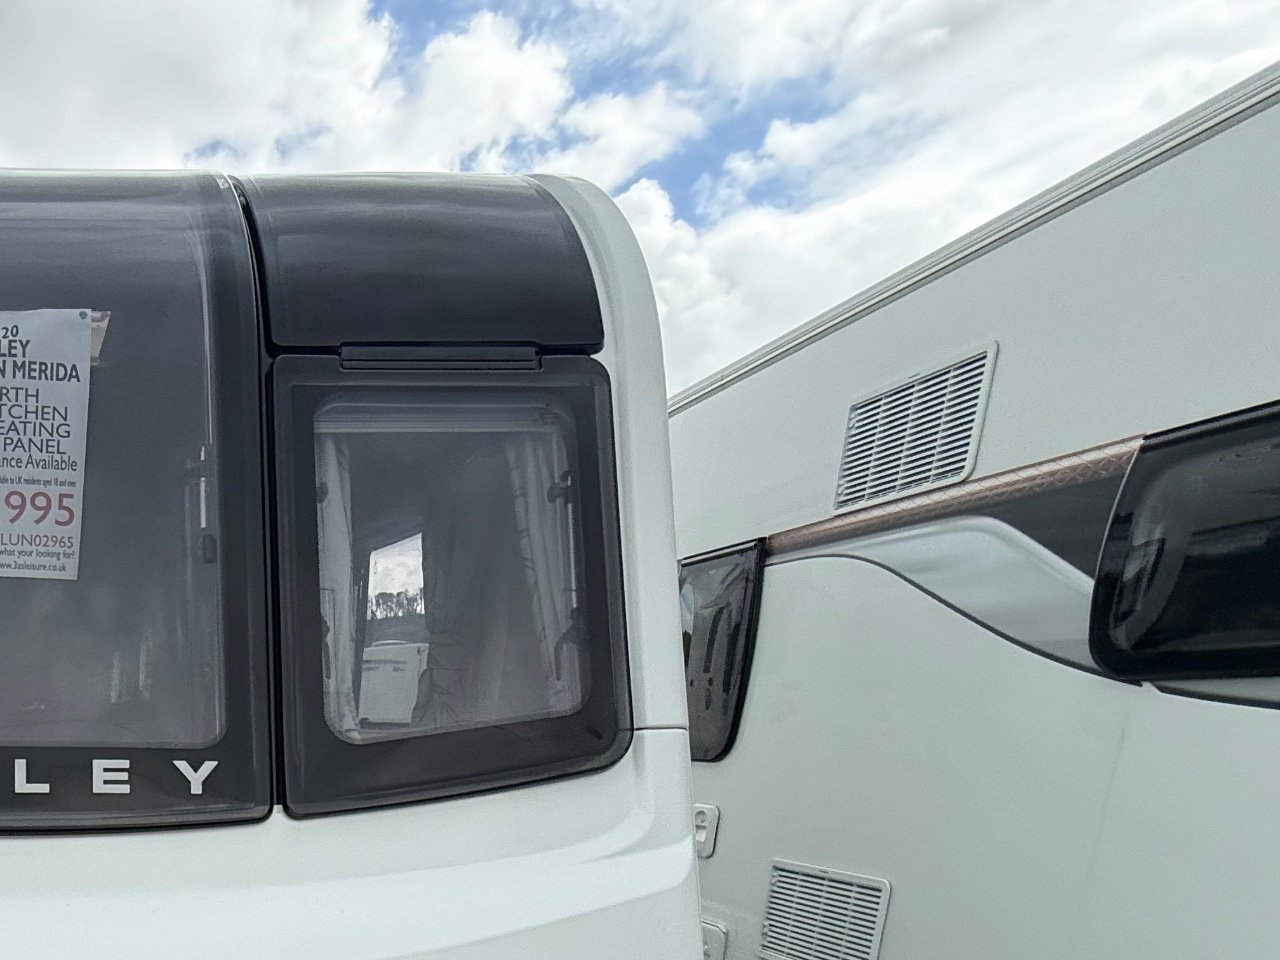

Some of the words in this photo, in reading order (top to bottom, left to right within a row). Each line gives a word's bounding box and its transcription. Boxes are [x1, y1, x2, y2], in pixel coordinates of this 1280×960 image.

[12, 360, 81, 383] MERIDA
[3, 437, 67, 455] PANEL
[24, 454, 78, 472] Available
[17, 550, 34, 560] your
[35, 549, 61, 561] looking
